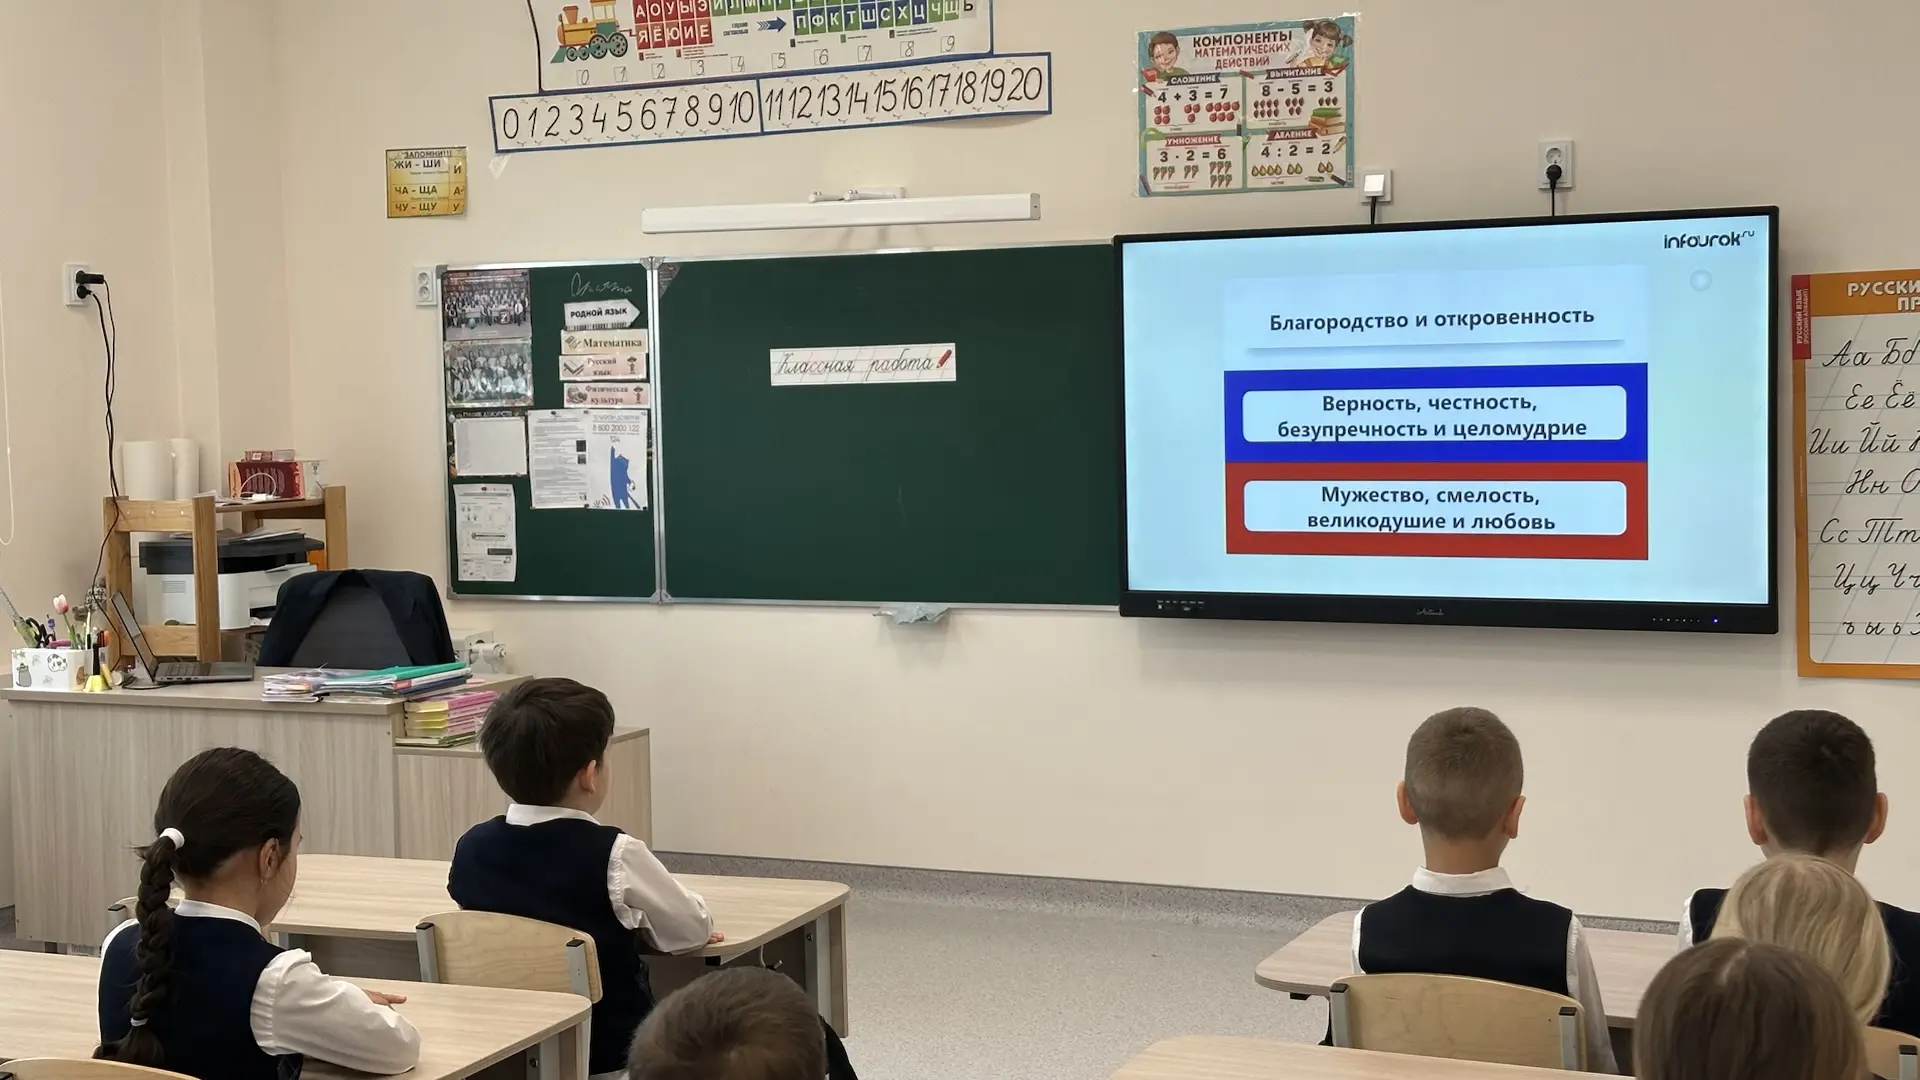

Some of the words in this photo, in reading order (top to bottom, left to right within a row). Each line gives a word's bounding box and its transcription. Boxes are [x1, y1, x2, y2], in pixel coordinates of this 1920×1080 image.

[1193, 30, 1292, 49] КОМПОНЕНТЫ
[1194, 42, 1290, 59] МАТЕМАТИЧЕСКИХ
[580, 69, 590, 85] 0
[619, 66, 627, 82] 1
[656, 63, 666, 79] 2
[696, 59, 705, 76] 3
[736, 56, 745, 72] 4
[776, 53, 787, 69] 5
[818, 48, 829, 65] 6
[862, 45, 872, 61] 7
[905, 41, 915, 57] 8
[945, 35, 955, 52] 9
[1215, 56, 1270, 70] ДЕЙСТВИЙ
[1170, 75, 1217, 85] СЛОЖЕНИЕ
[1270, 68, 1322, 78] ВЫЧИТАНИЕ
[765, 87, 785, 121] 11
[789, 86, 813, 119] 12
[817, 83, 841, 117] 13
[845, 81, 869, 115] 14
[874, 78, 897, 113] 15
[901, 76, 924, 110] 16
[927, 73, 951, 108] 17
[954, 70, 977, 105] 18
[981, 68, 1005, 103] 19
[1007, 66, 1043, 101] 20
[1158, 92, 1167, 103] 4
[1189, 90, 1198, 101] 3
[1220, 88, 1228, 99] 7
[1262, 85, 1271, 97] 8
[1291, 83, 1300, 95] 5
[1324, 81, 1333, 93] 3
[503, 108, 520, 140] 0
[527, 107, 538, 139] 1
[545, 105, 561, 137] 2
[569, 104, 584, 136] 3
[592, 102, 607, 133] 4
[616, 100, 633, 132] 5
[640, 98, 657, 131] 6
[662, 97, 678, 130] 7
[684, 94, 700, 128] 8
[708, 93, 723, 126] 9
[729, 90, 755, 125] 10
[1167, 136, 1219, 145] УМНОЖЕНИЕ
[1274, 130, 1313, 139] ДЕЛЕНИЕ
[1160, 151, 1168, 163] 3
[1186, 150, 1195, 161] 2
[1217, 148, 1226, 160] 6
[1261, 146, 1270, 158] 4
[1289, 145, 1298, 157] 2
[1322, 143, 1330, 155] 2
[394, 160, 412, 169] ЖИ
[423, 159, 441, 168] ШИ
[395, 186, 409, 195] ЧА
[419, 185, 438, 195] ЩА
[395, 203, 409, 212] ЧУ
[419, 202, 437, 212] ЩУ
[1795, 289, 1803, 310] ЯЗЫК
[571, 308, 603, 318] РОДНОЙ
[604, 308, 628, 316] ЯЗЫК
[1270, 314, 1409, 335] Благородство
[1416, 316, 1428, 327] и
[1434, 310, 1595, 331] откровенность
[1795, 311, 1803, 344] РУССКИЙ
[583, 338, 642, 348] Математика
[587, 357, 617, 366] Русский
[1822, 339, 1872, 367] Аа
[777, 352, 855, 374] Классная
[864, 348, 934, 381] работа
[585, 385, 629, 393] Физическая
[1845, 383, 1875, 410] Ее
[1885, 379, 1916, 410] Ёё
[591, 397, 623, 405] культура
[1322, 395, 1422, 415] Верность,
[1428, 396, 1537, 412] честность,
[1277, 422, 1428, 442] безупречность
[1434, 424, 1446, 437] и
[1453, 422, 1588, 441] целомудрие
[1809, 428, 1850, 455] Ии
[1859, 421, 1901, 453] Йй
[1845, 469, 1890, 494] Нн
[1321, 486, 1429, 507] Мужество,
[1436, 490, 1540, 506] смелость,
[1307, 514, 1446, 533] великодушие
[1453, 517, 1465, 529] и
[1471, 513, 1556, 530] любовь
[1820, 518, 1849, 543] Сс
[1834, 563, 1880, 595] Цц
